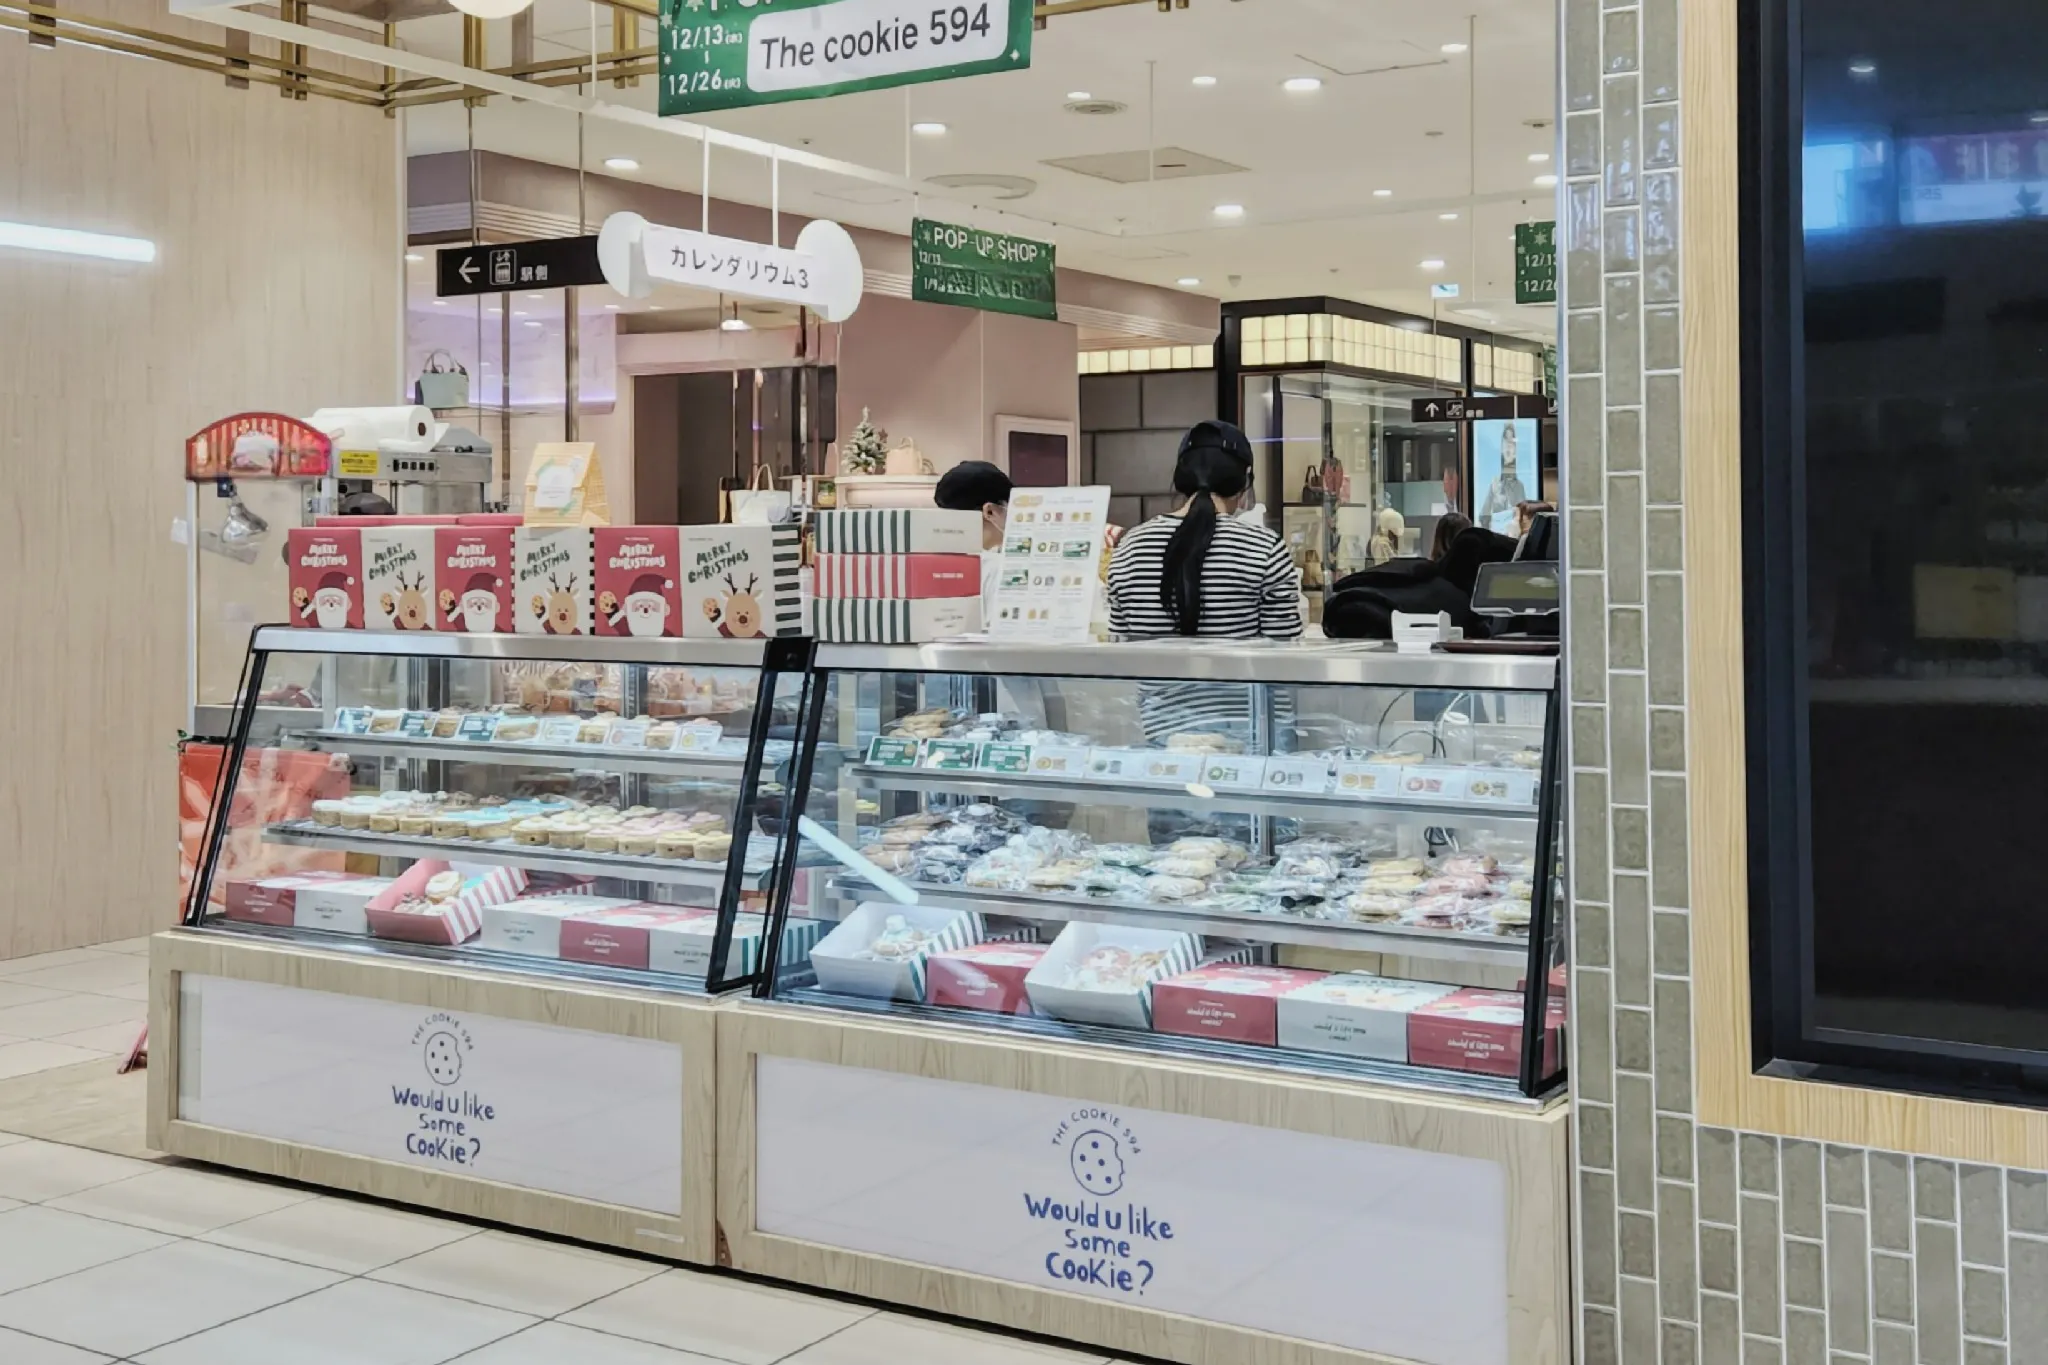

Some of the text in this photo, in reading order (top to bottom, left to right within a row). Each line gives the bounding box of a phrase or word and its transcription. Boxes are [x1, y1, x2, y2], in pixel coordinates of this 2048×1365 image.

[760, 2, 990, 70] The cookie 594
[933, 226, 1037, 263] POP-UP SHOP
[671, 245, 809, 289] カレンダリウム3
[368, 550, 417, 580] CHRISTMAS
[374, 543, 402, 564] MERRY
[527, 542, 556, 564] MERRY
[609, 555, 666, 570] CHRISTMAS
[619, 543, 655, 557] MERRY
[696, 541, 731, 565] MERRY
[520, 550, 570, 581] CHRISTMAS
[688, 549, 749, 583] CHRISTMAS
[391, 1084, 444, 1112] Would
[463, 1090, 496, 1121] like
[419, 1113, 466, 1137] Some
[1052, 1120, 1070, 1147] THE
[1071, 1108, 1121, 1128] COOKIE
[1023, 1192, 1099, 1229] Would
[1129, 1203, 1174, 1241] like
[1065, 1228, 1131, 1258] Some
